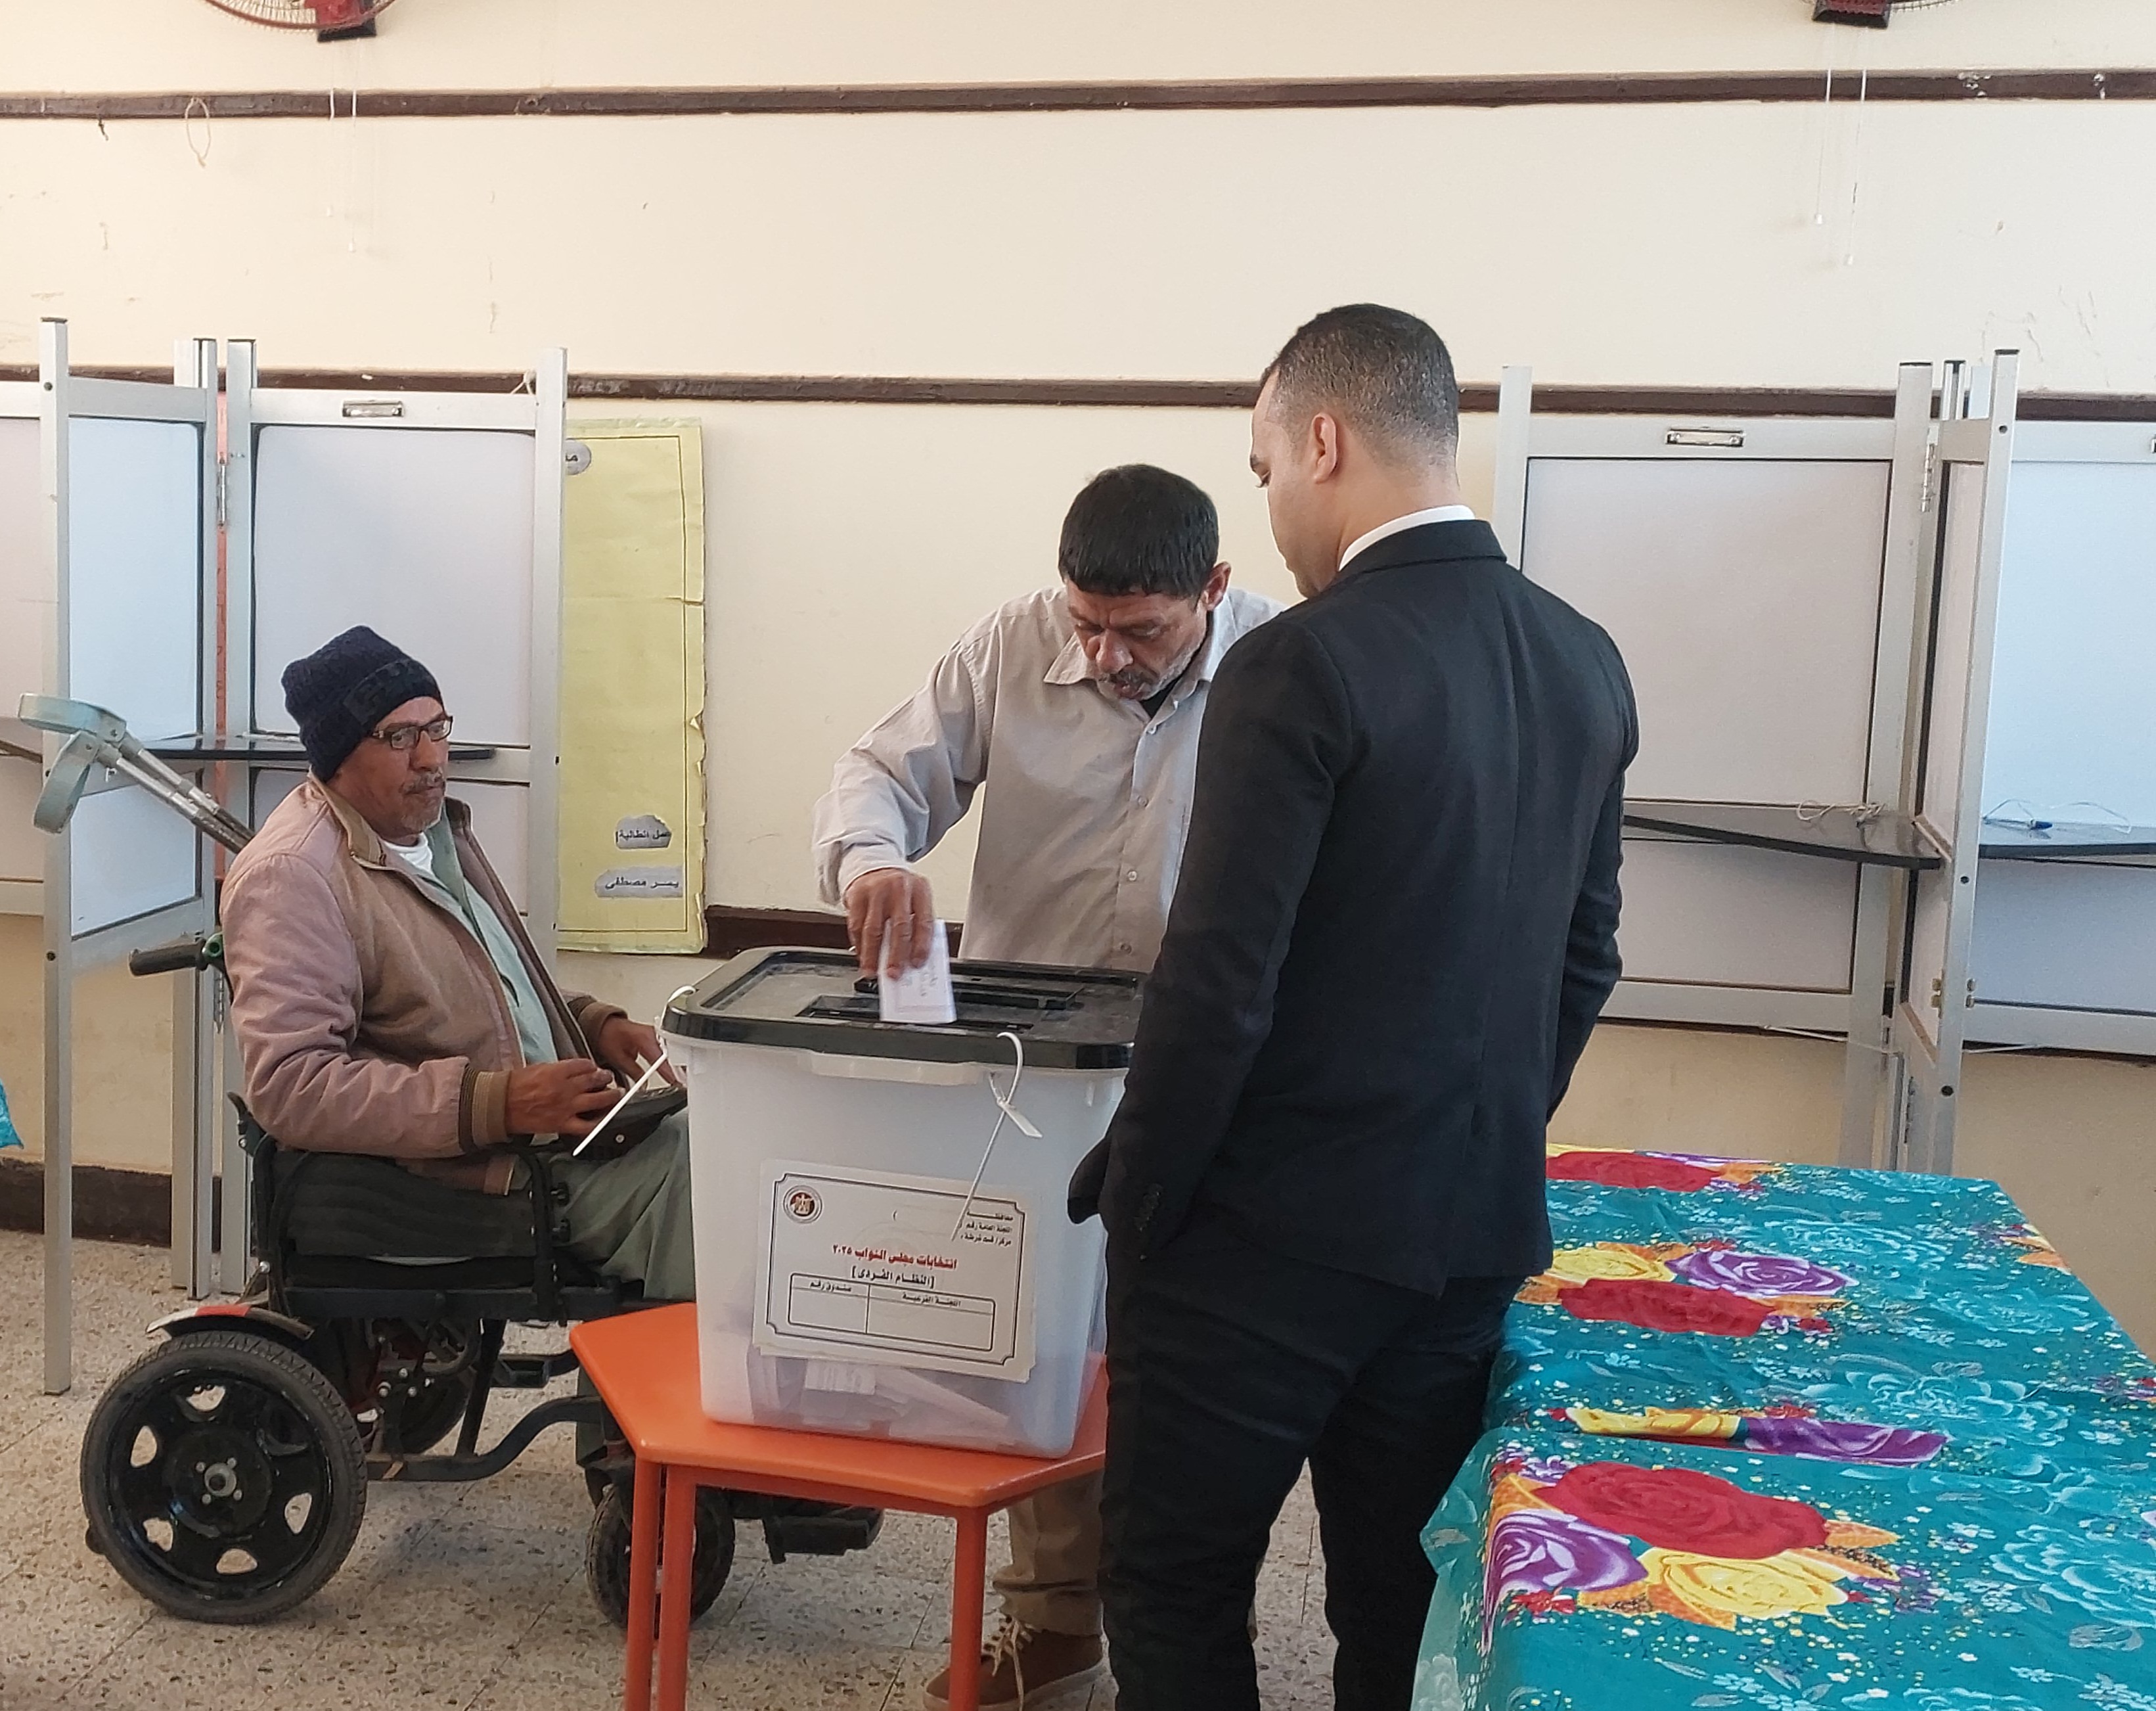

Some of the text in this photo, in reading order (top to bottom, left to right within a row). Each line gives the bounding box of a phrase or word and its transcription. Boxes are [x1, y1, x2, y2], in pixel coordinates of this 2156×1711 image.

[604, 875, 647, 890] مصطفى
[832, 1244, 958, 1270] انتخابات مجلس النواب ٢٠٢٥
